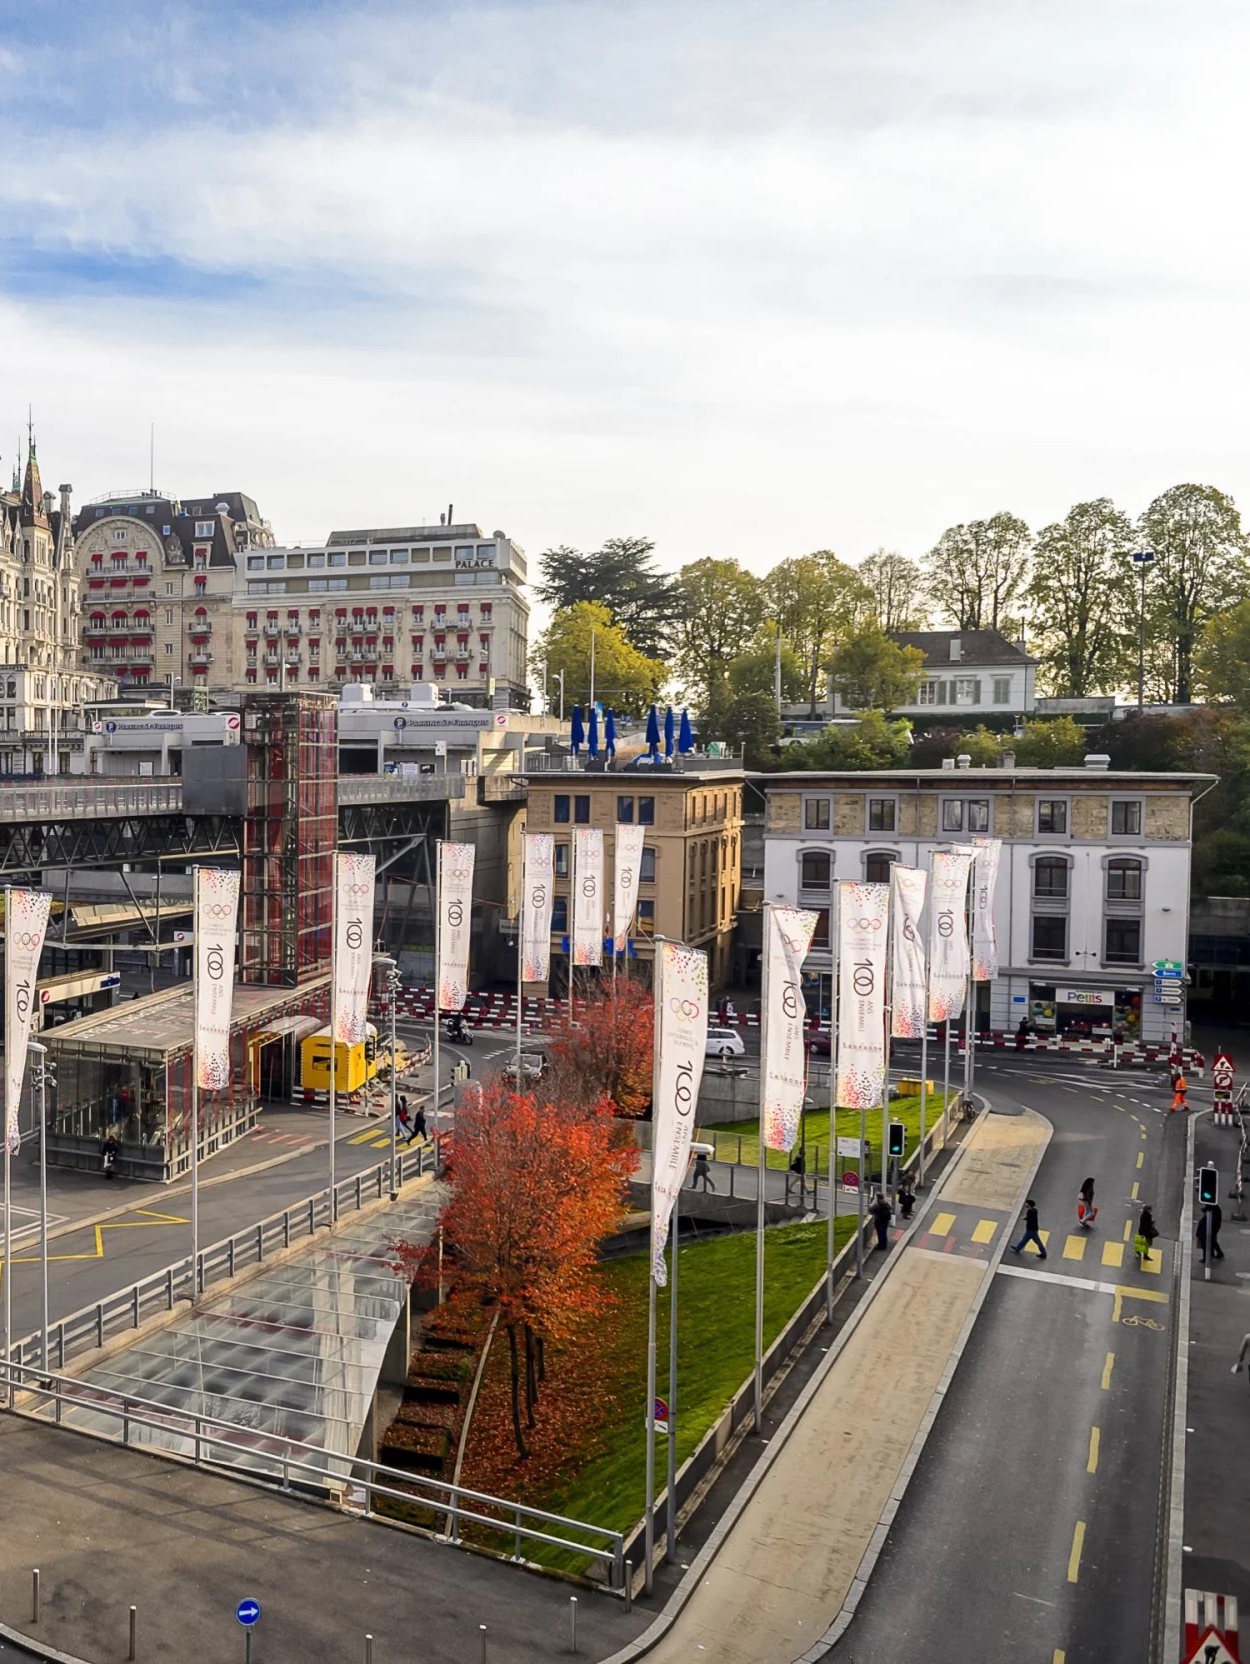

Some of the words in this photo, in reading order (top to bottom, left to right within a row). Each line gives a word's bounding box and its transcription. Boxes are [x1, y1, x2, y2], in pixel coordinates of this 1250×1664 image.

[455, 559, 494, 569] PALACE
[532, 883, 546, 908] 100
[582, 874, 596, 898] 100
[448, 898, 463, 927] 100
[937, 908, 954, 938] 100
[346, 917, 363, 950] 100
[206, 943, 224, 980] 100
[853, 958, 874, 996] 100
[674, 1060, 693, 1117] 100
[669, 1120, 683, 1170] ENSEMBLE
